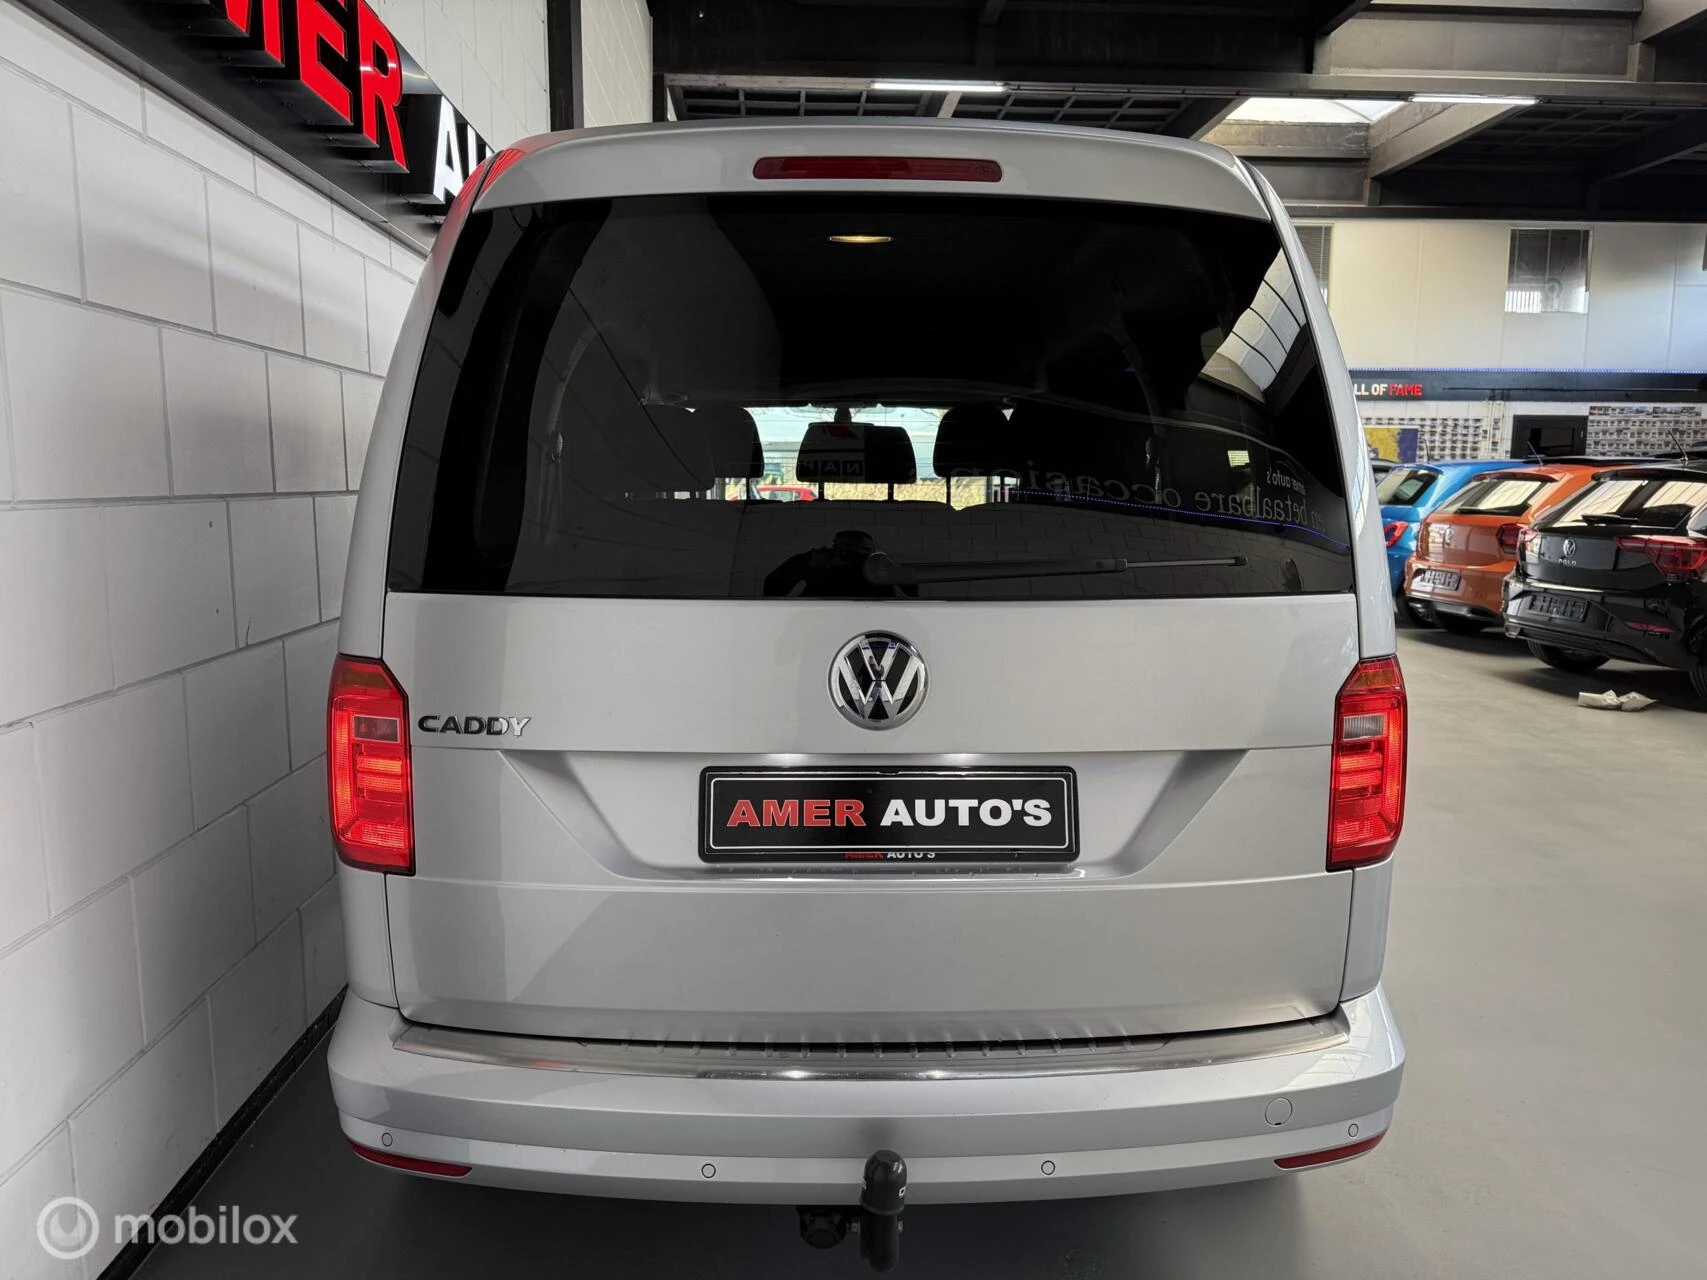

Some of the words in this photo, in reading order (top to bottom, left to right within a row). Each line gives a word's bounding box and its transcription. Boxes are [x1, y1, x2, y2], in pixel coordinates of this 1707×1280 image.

[1371, 383, 1388, 396] OF
[1389, 383, 1423, 396] FAME
[417, 715, 531, 737] CADDY
[726, 799, 867, 828] AMER
[879, 799, 1053, 828] AUTO'S
